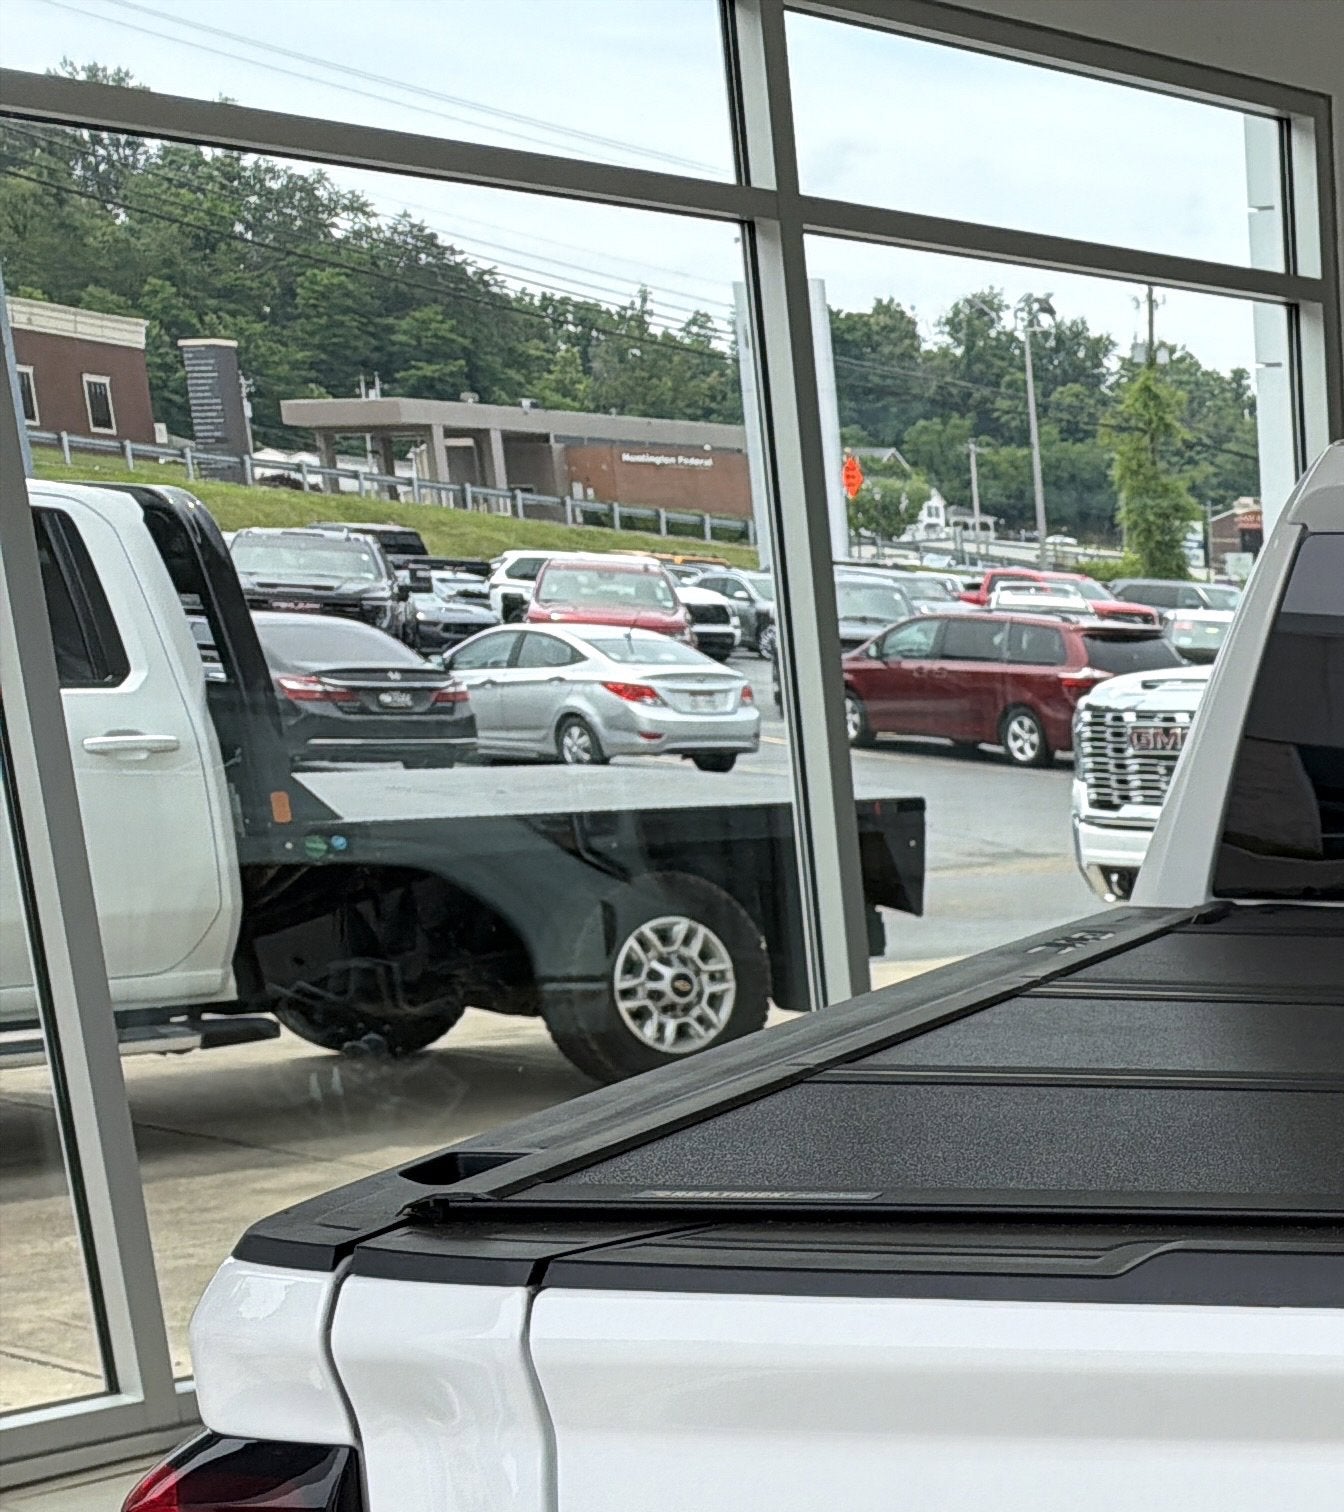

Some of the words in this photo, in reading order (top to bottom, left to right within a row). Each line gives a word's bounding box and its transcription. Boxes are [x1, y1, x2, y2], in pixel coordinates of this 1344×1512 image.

[622, 453, 676, 465] Huntington
[678, 456, 713, 466] Federal
[1130, 727, 1190, 751] GM
